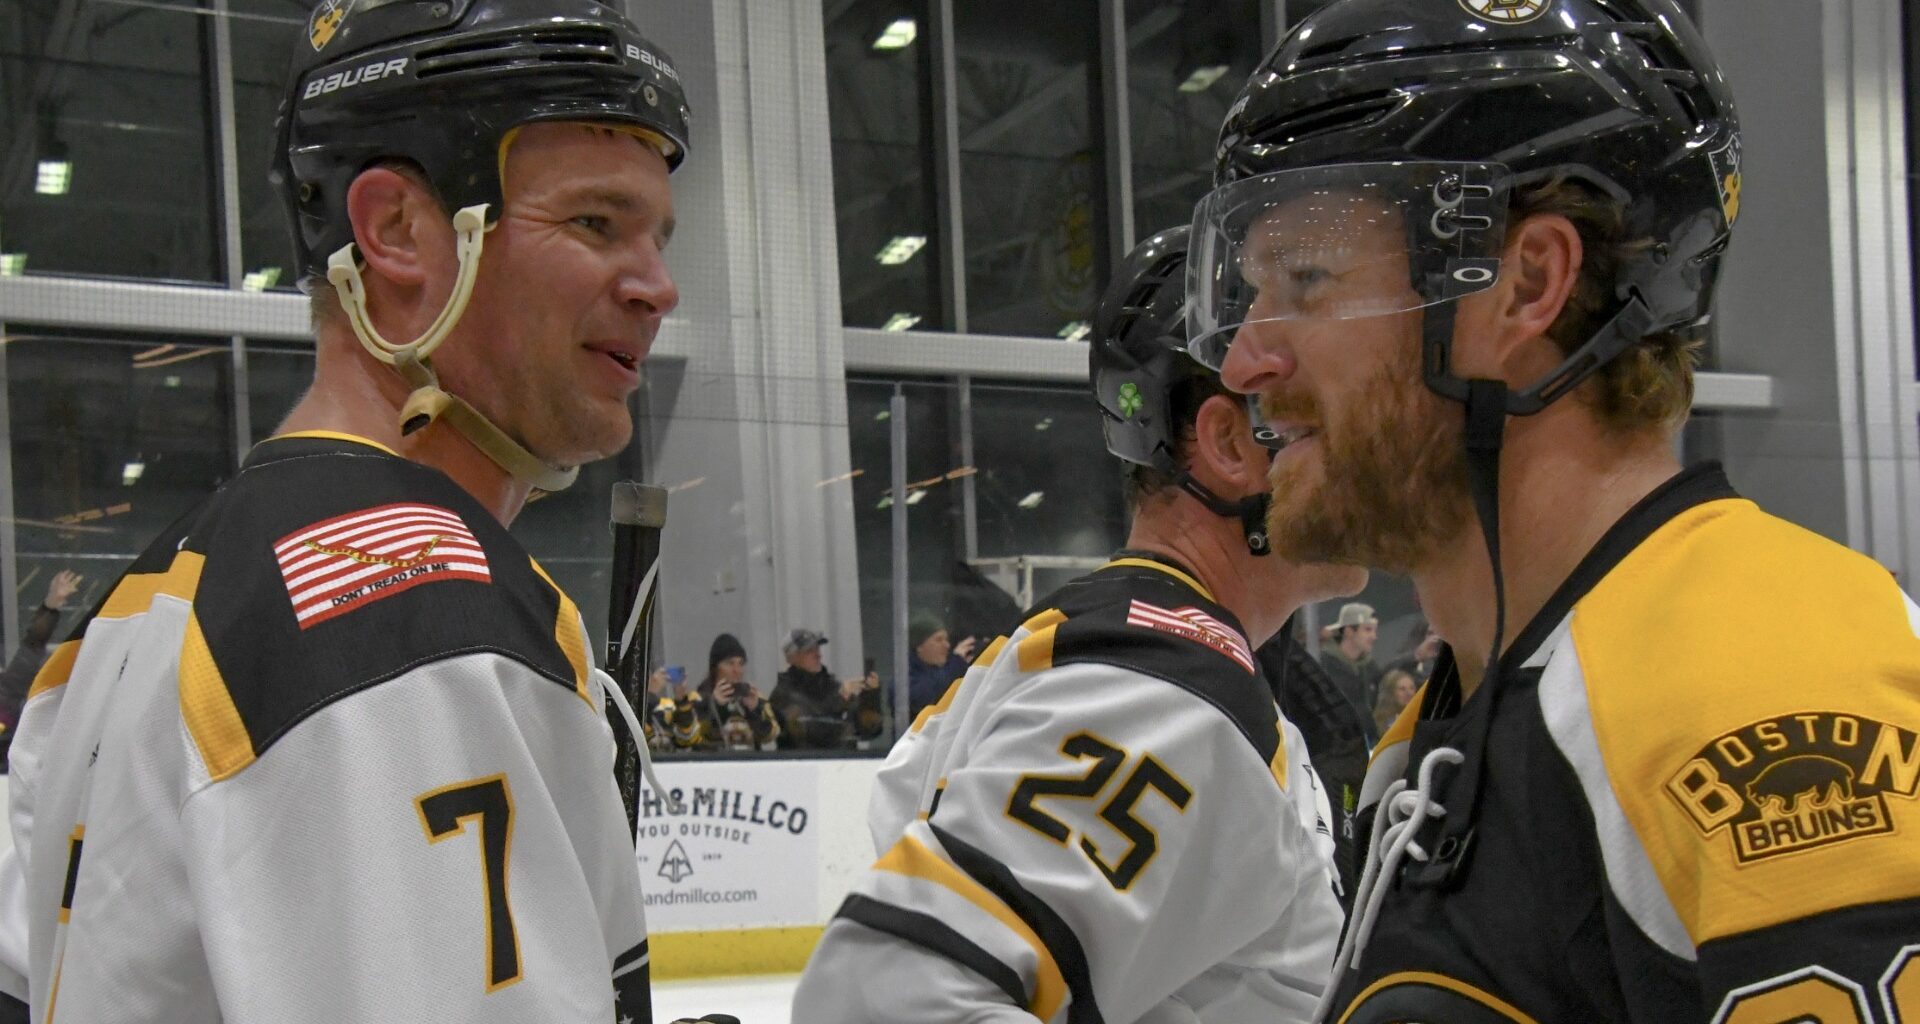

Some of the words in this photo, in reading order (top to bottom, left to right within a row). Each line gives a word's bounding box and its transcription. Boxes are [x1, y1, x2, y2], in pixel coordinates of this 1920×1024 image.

[331, 588, 364, 607] DONT
[368, 572, 408, 593] TREAD
[409, 566, 428, 577] ON
[431, 562, 450, 572] ME
[1003, 729, 1194, 897] 25
[1665, 714, 1920, 832] BOSTON
[638, 824, 670, 839] YOU
[679, 823, 752, 845] OUTSIDE
[1746, 801, 1878, 851] BRUINS
[412, 771, 525, 995] 7
